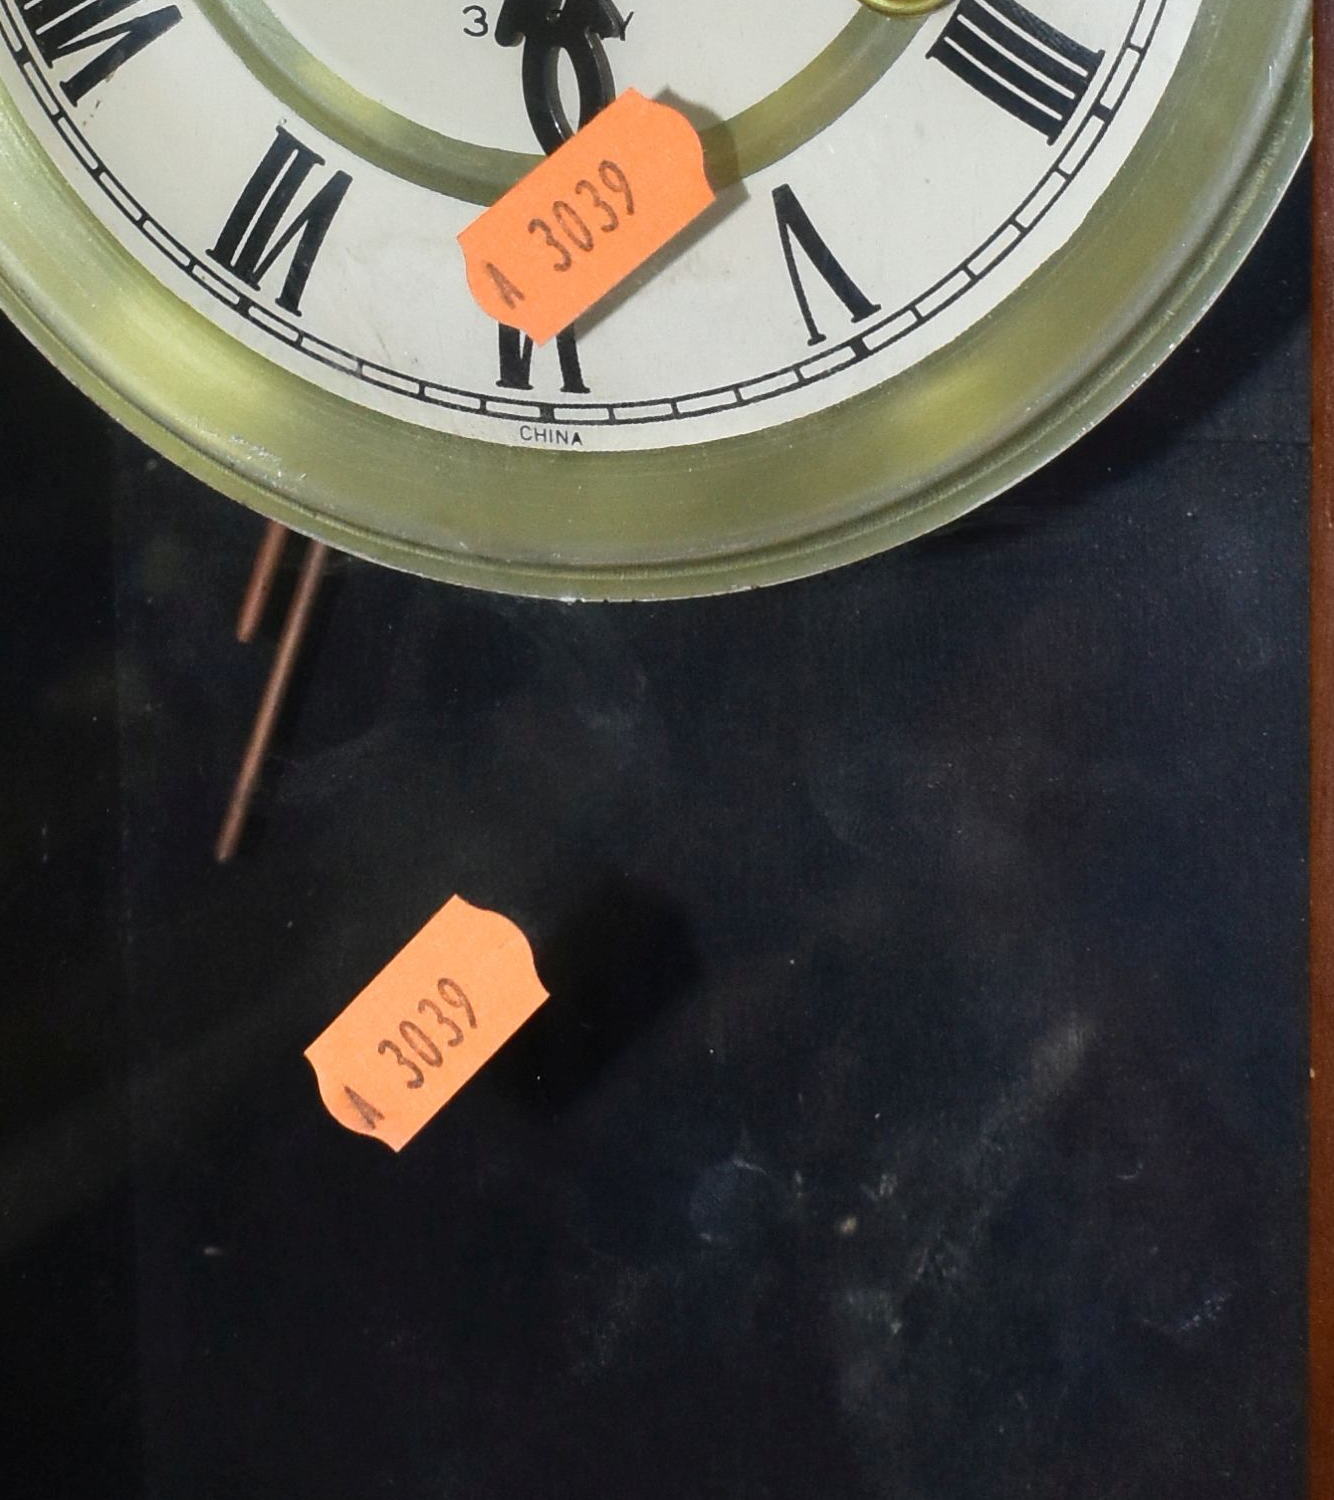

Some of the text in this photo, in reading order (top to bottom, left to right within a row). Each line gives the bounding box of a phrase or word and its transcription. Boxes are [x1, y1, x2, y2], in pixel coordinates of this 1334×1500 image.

[205, 125, 354, 317] VII
[485, 159, 636, 310] A 3039
[772, 183, 882, 346] V
[519, 424, 584, 448] CHINA
[343, 977, 478, 1130] A 3039
